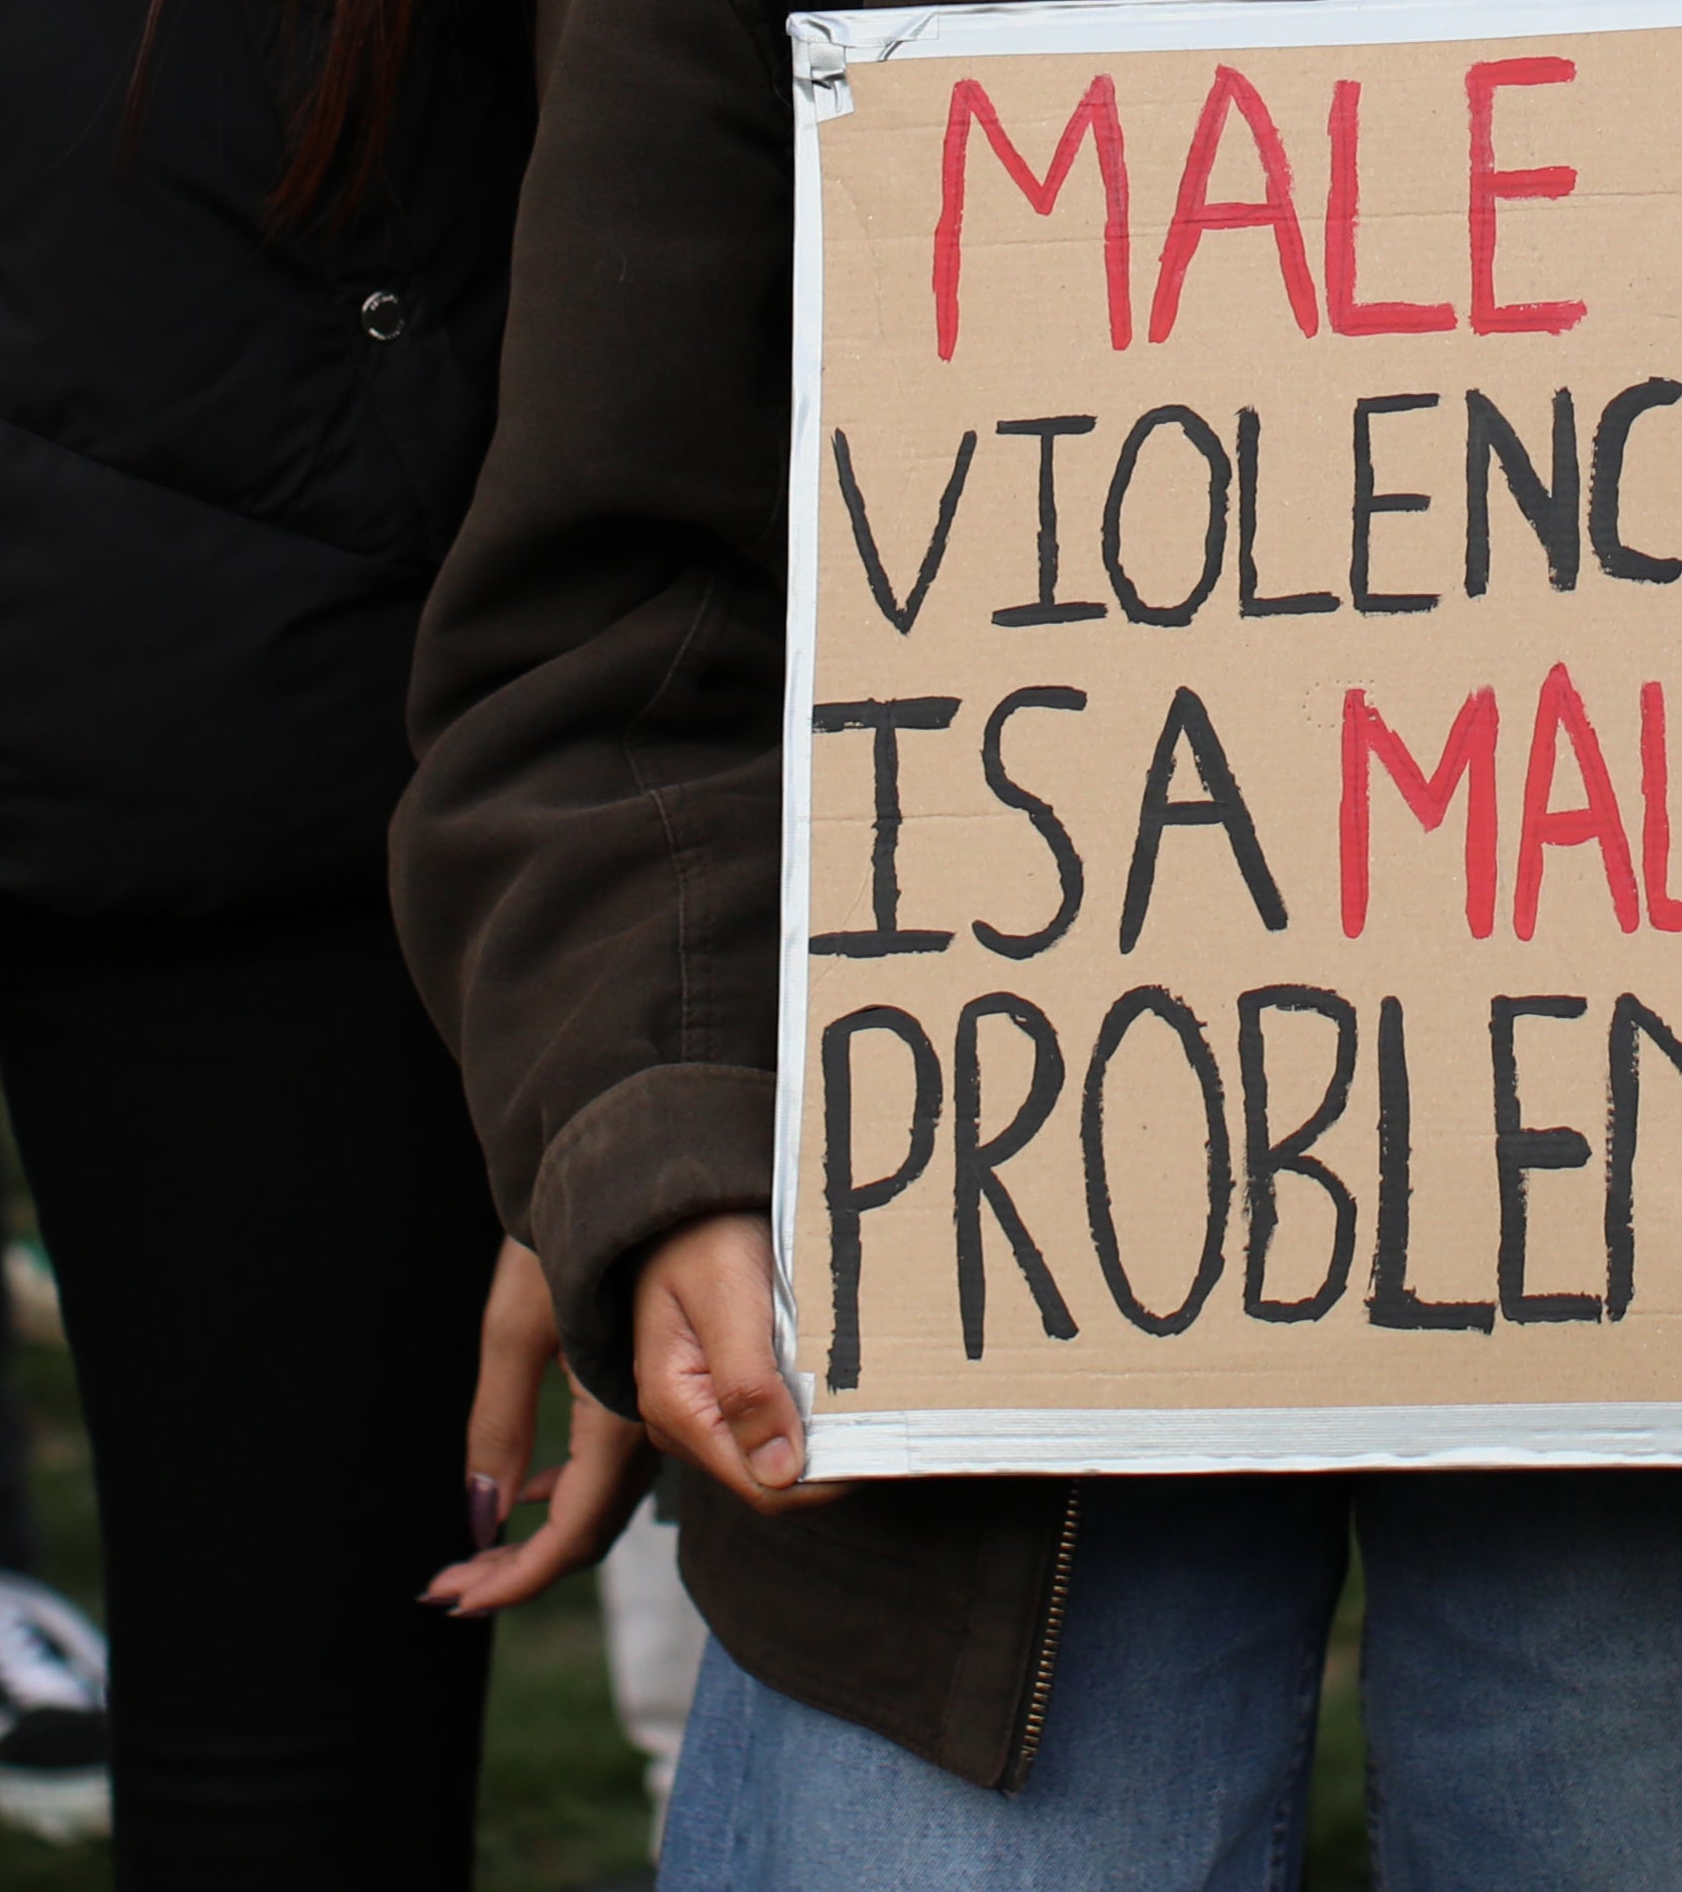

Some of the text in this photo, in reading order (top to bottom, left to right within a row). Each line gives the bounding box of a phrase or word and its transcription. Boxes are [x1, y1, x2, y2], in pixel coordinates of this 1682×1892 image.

[932, 56, 1588, 362] MALE
[808, 685, 1088, 961] IS
[1119, 686, 1289, 955] A
